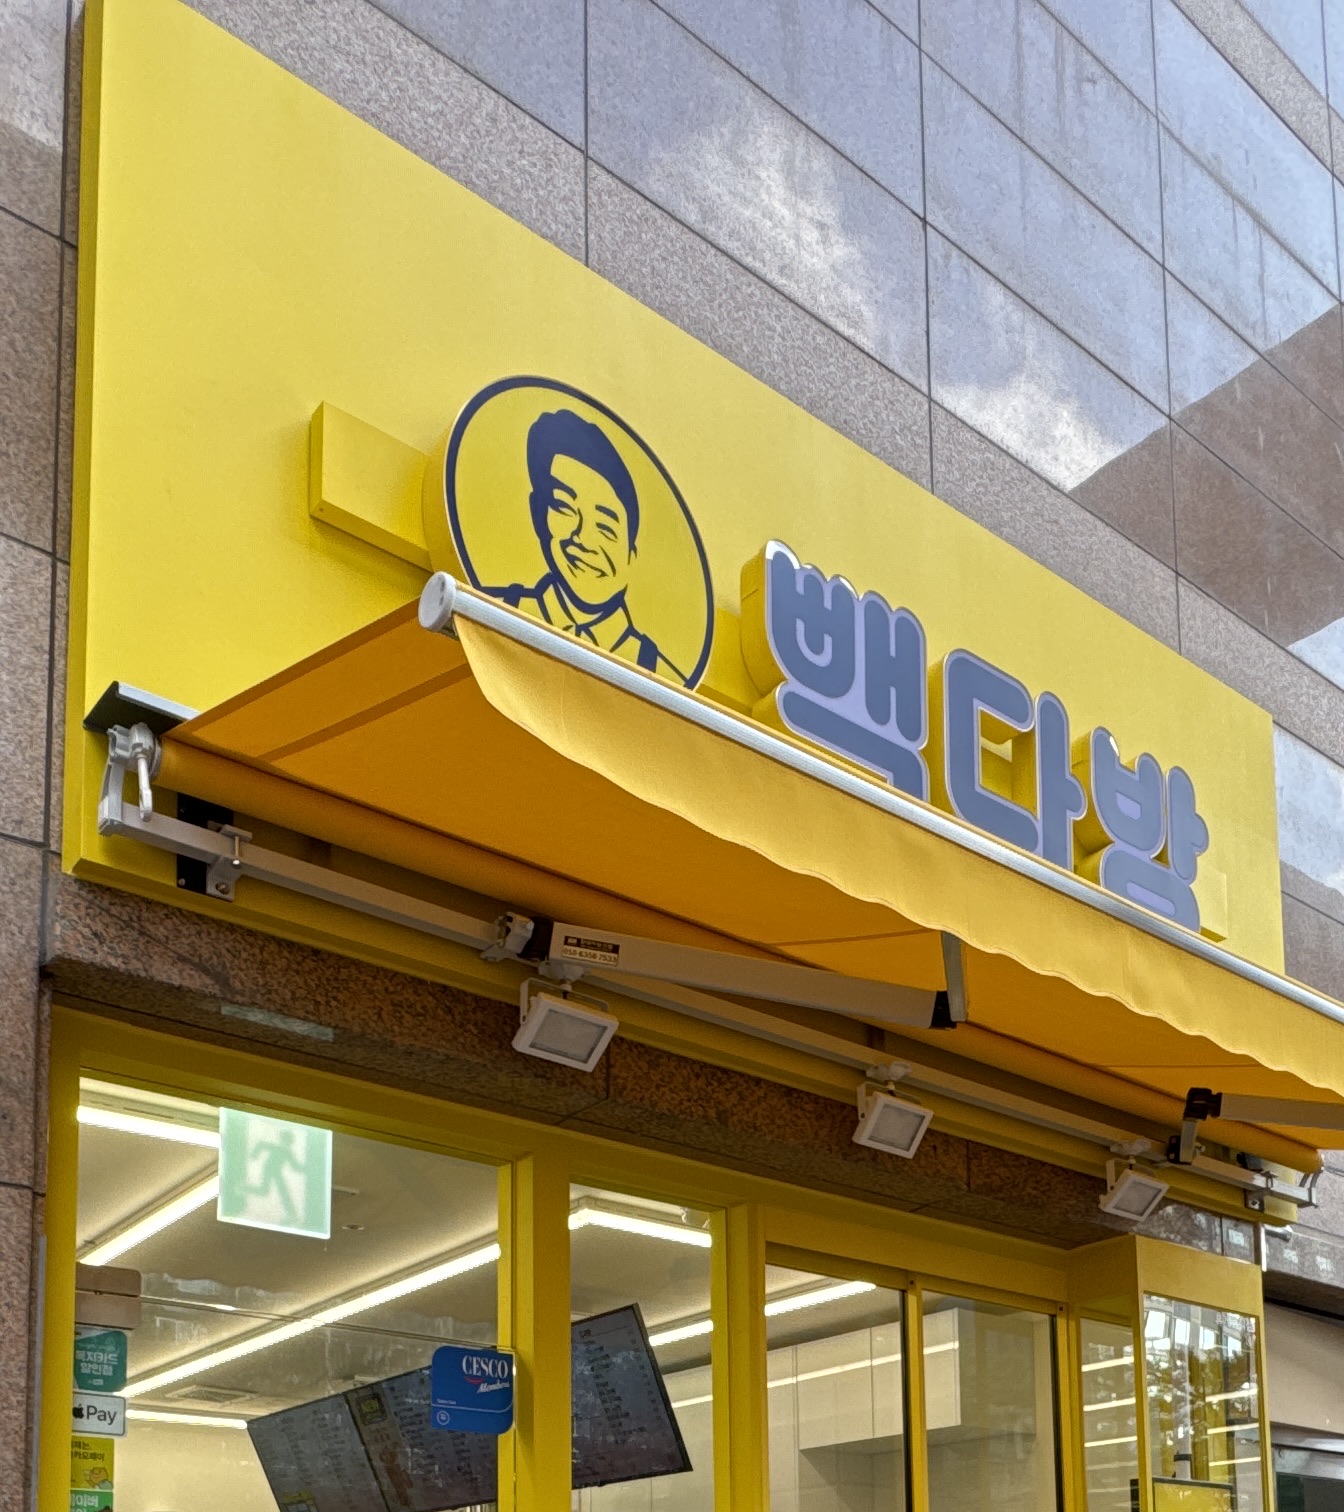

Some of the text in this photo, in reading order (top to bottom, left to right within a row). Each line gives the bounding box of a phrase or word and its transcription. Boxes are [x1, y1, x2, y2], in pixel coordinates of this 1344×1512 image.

[764, 538, 1209, 936] 빽다방
[462, 1355, 509, 1379] CESCO
[87, 1405, 117, 1425] Pay
[71, 1450, 106, 1462] 카오페이
[71, 1494, 99, 1508] 이버
